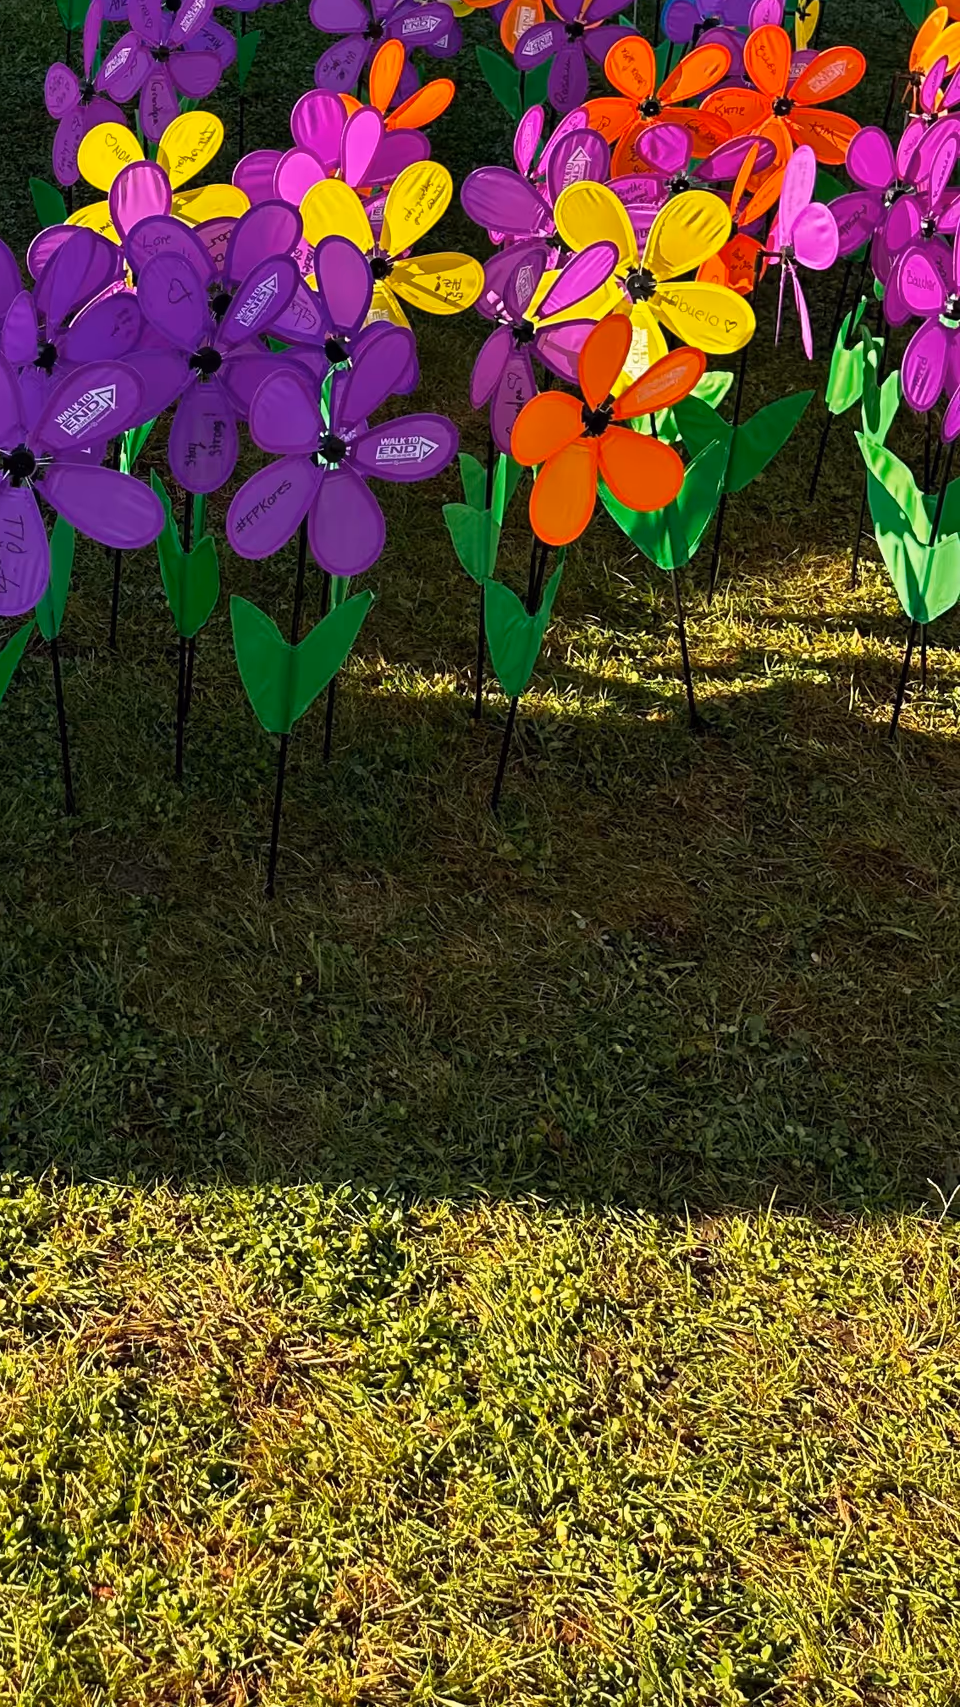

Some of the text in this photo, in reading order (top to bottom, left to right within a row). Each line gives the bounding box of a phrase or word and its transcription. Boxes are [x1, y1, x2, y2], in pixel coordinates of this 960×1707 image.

[150, 81, 164, 126] Grandpa
[235, 287, 263, 322] WALK TO
[241, 291, 271, 323] END
[54, 393, 92, 424] WALK TO
[63, 398, 101, 435] END
[184, 442, 206, 467] Stay
[378, 445, 418, 455] END
[381, 437, 407, 445] WALK
